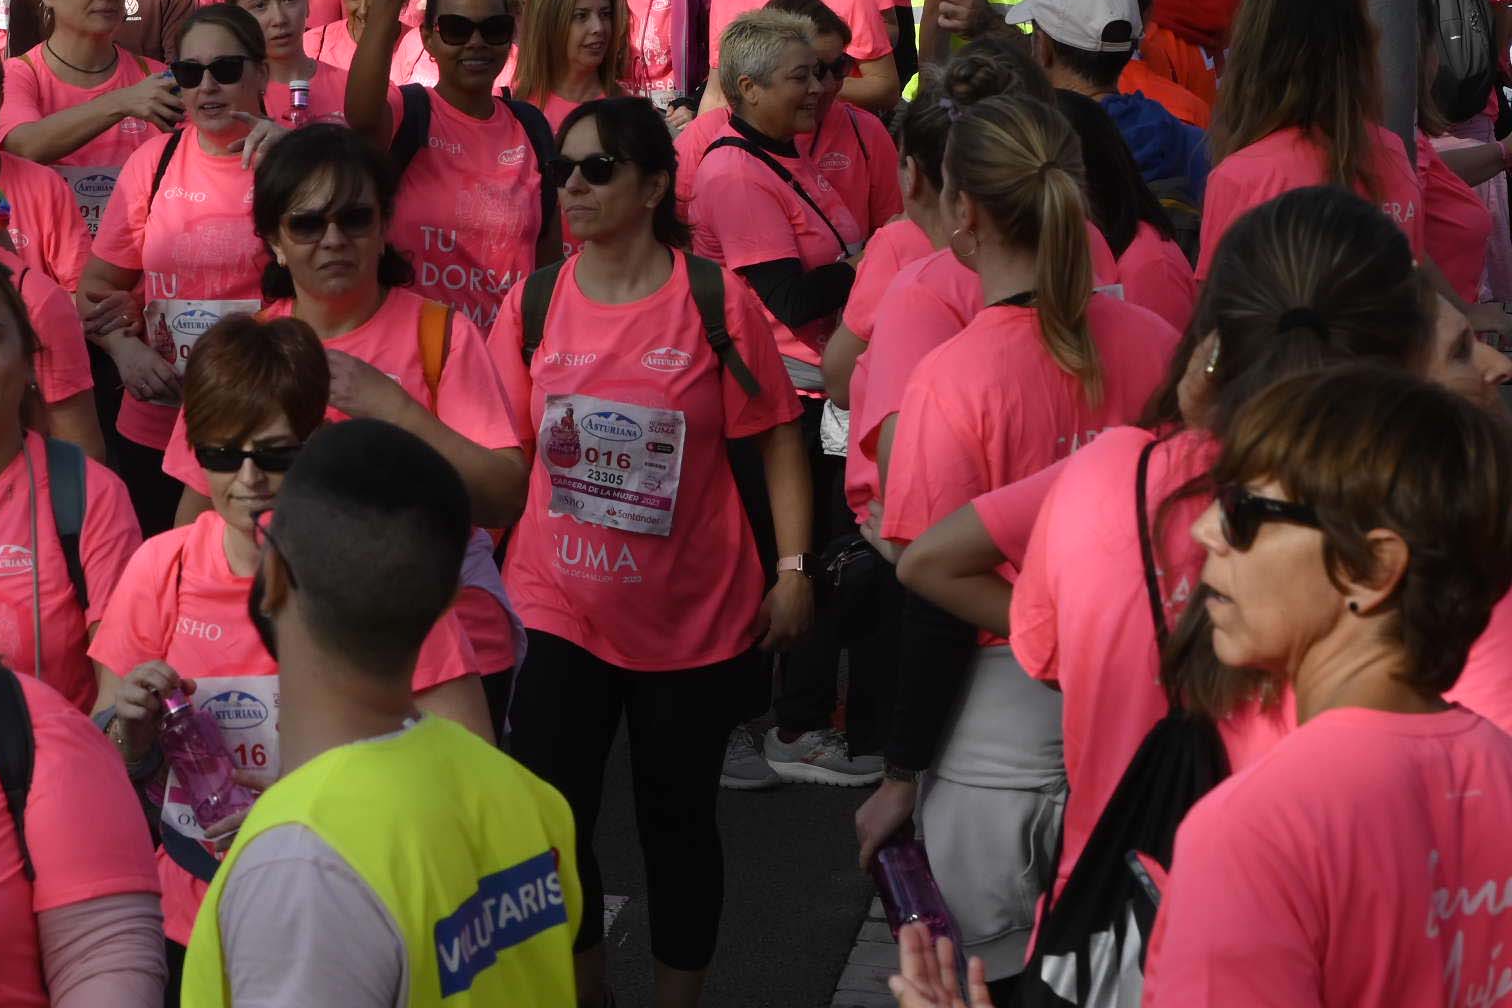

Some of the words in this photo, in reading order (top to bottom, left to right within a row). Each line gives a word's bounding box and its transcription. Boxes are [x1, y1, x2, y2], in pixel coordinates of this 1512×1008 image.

[80, 205, 101, 218] 01
[420, 226, 457, 253] TU
[544, 351, 597, 367] OYSHO
[585, 420, 639, 439] ASTURIANA
[584, 447, 632, 471] 016
[587, 468, 624, 486] 23305
[589, 484, 600, 493] DE
[600, 487, 612, 497] LA
[612, 490, 640, 503] MUJER
[616, 510, 662, 526] Santander
